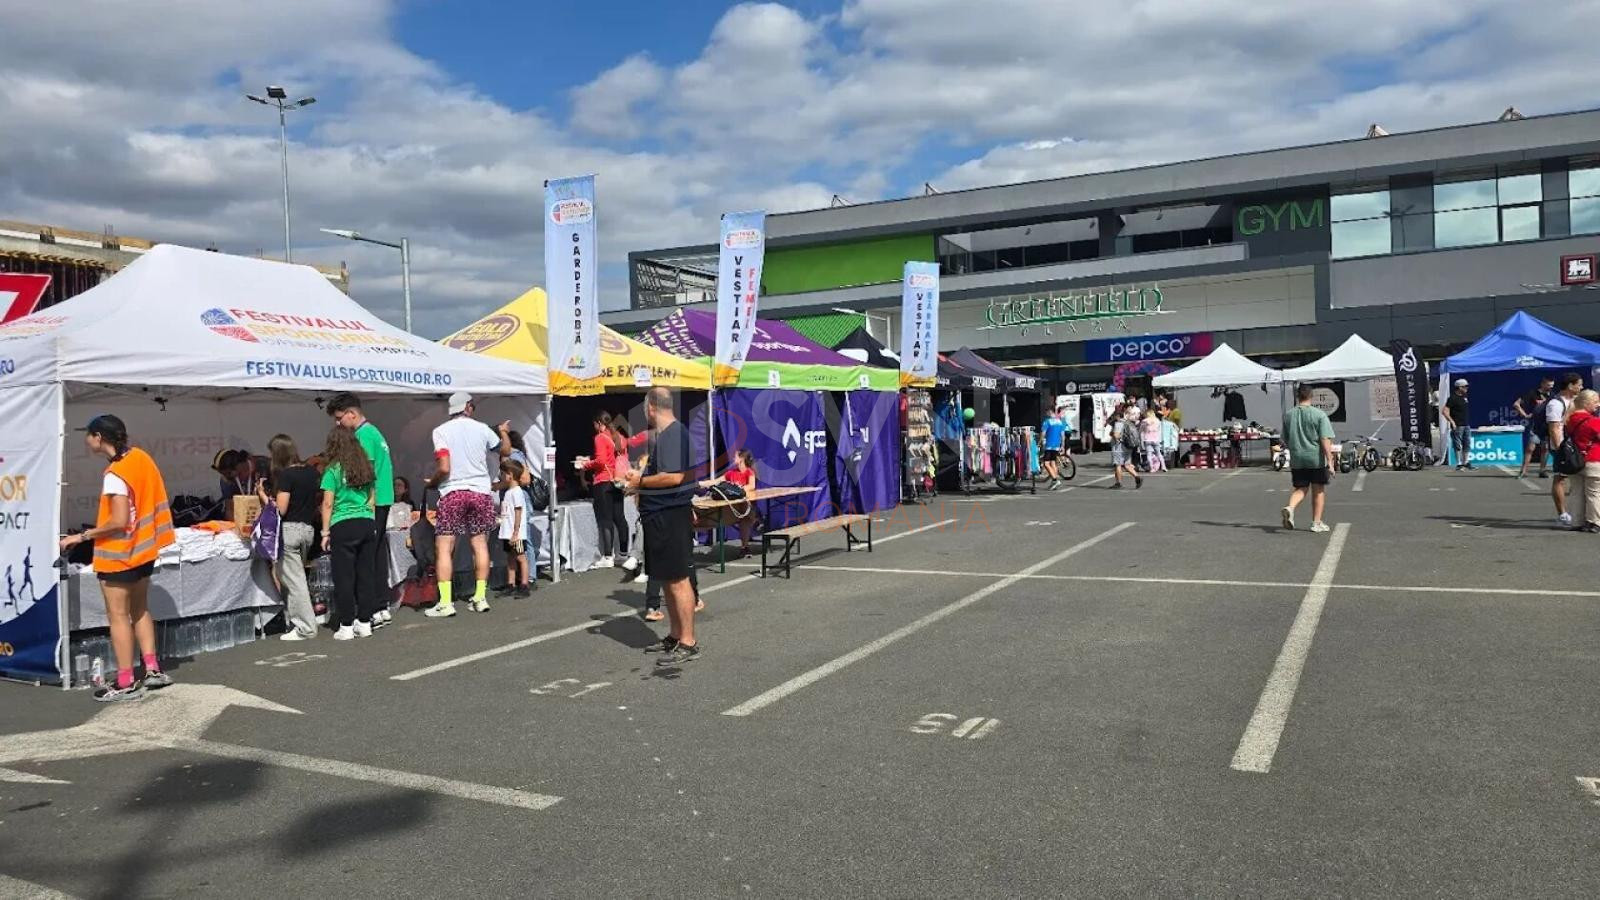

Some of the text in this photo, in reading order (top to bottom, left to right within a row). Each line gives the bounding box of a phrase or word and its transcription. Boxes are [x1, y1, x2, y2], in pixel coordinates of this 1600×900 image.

[1238, 199, 1323, 234] GYM
[572, 233, 582, 344] GARDEROBĂ
[731, 256, 743, 343] VESTIAR
[745, 268, 757, 329] FEMEI
[230, 308, 376, 333] FESTIVALUL
[985, 287, 1164, 326] GREENFIELD
[913, 292, 923, 358] VESTIAR
[1021, 318, 1131, 337] PLAZA
[246, 360, 452, 386] FESTIVALULSPORTURILOR.RO
[617, 364, 677, 380] EXCLENT
[1470, 437, 1493, 449] lot
